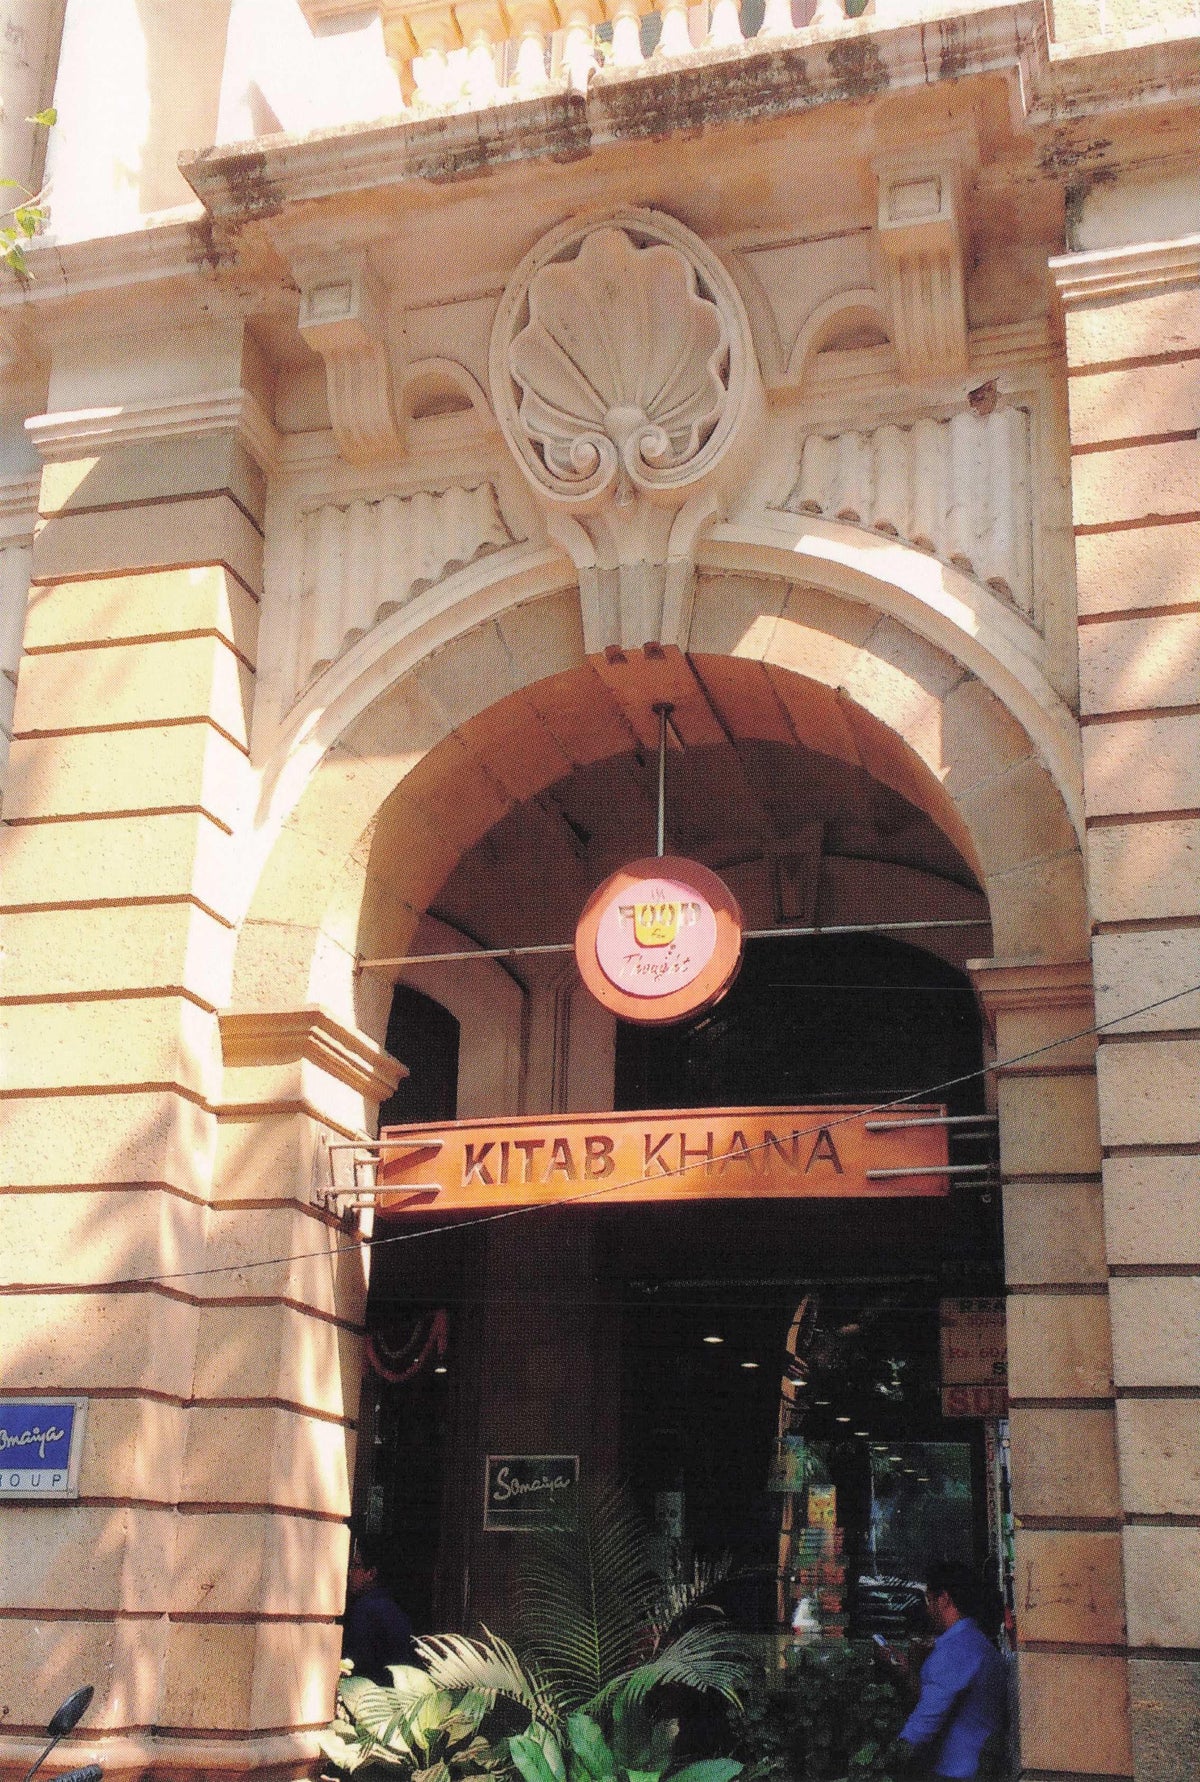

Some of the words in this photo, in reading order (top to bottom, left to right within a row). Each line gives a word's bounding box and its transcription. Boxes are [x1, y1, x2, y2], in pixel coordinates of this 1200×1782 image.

[618, 903, 700, 927] FOOD
[462, 1135, 616, 1186] KITAB
[643, 1129, 844, 1177] KHANA
[0, 1426, 65, 1459] omaiya
[493, 1467, 570, 1502] Somaiya
